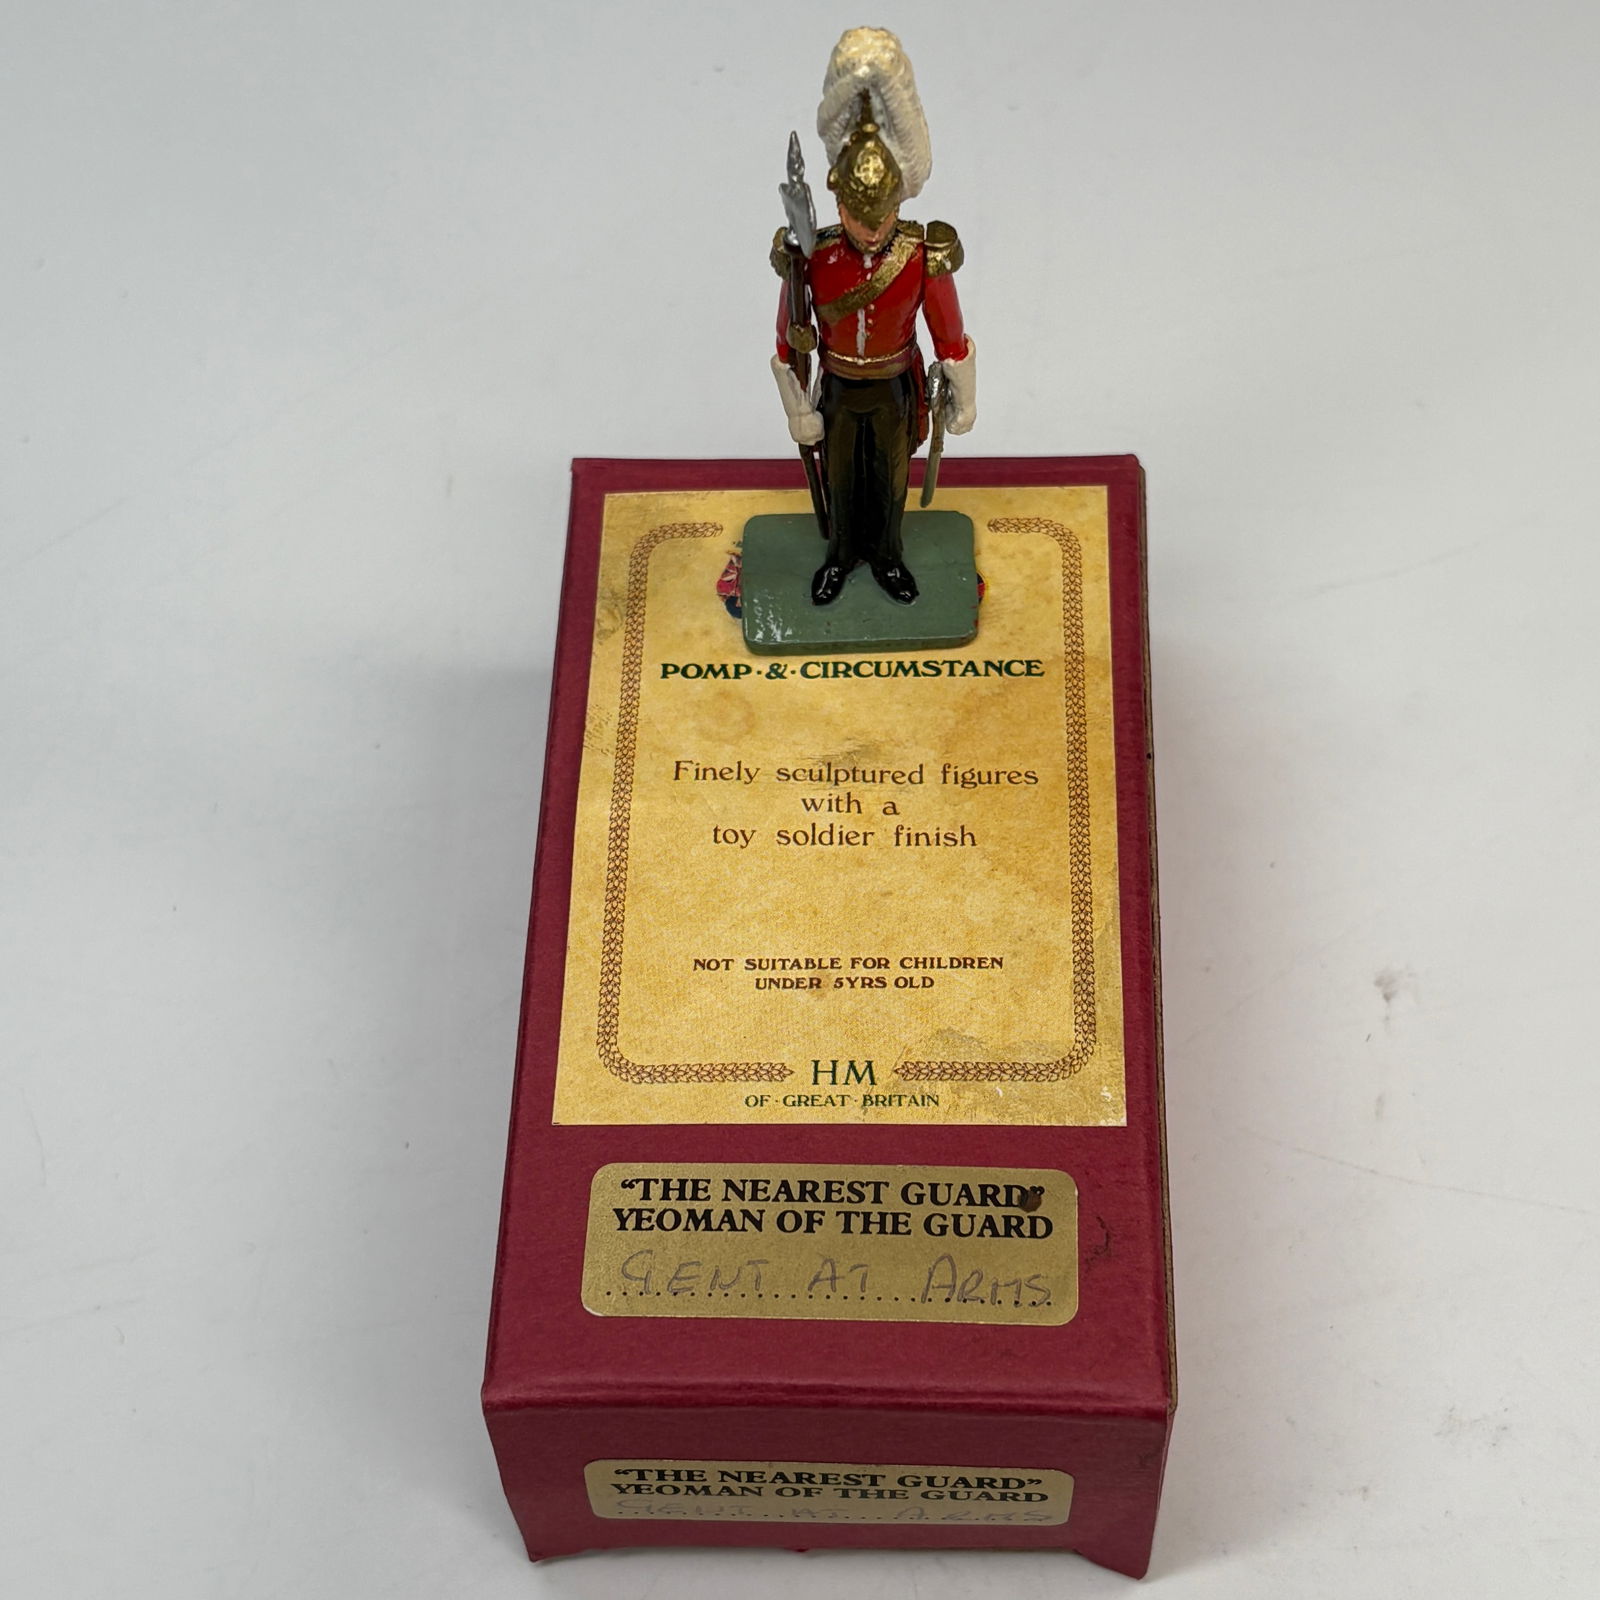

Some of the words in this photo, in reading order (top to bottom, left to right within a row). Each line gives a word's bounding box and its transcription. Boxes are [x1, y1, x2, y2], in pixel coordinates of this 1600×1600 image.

[673, 760, 760, 784] Finely
[776, 763, 924, 786] sculptured
[941, 763, 1039, 788] figures
[801, 792, 862, 815] with
[882, 800, 900, 816] a
[713, 824, 755, 849] toy
[776, 825, 874, 847] soldier
[894, 825, 977, 848] finish
[693, 958, 734, 972] NOT
[744, 958, 842, 971] SUITABLE
[850, 957, 890, 970] FOR
[899, 956, 1004, 970] CHILDREN
[755, 976, 822, 990] UNDER
[834, 976, 887, 989] 5YRS
[894, 976, 935, 989] OLD
[811, 1060, 877, 1085] HM
[745, 1095, 771, 1107] OF
[782, 1095, 851, 1107] GREAT
[862, 1095, 940, 1107] BRITAIN
[724, 1179, 889, 1204] NEAREST
[613, 1208, 766, 1232] YEOMAN
[775, 1209, 826, 1234] OF
[835, 1210, 913, 1235] THE
[923, 1213, 1054, 1238] GUARD
[808, 1258, 870, 1292] AT
[718, 1470, 886, 1487] NEAREST
[610, 1483, 765, 1496] YEOMAN
[775, 1487, 821, 1499] OF
[833, 1487, 910, 1500] THE
[920, 1490, 1049, 1503] GUARD
